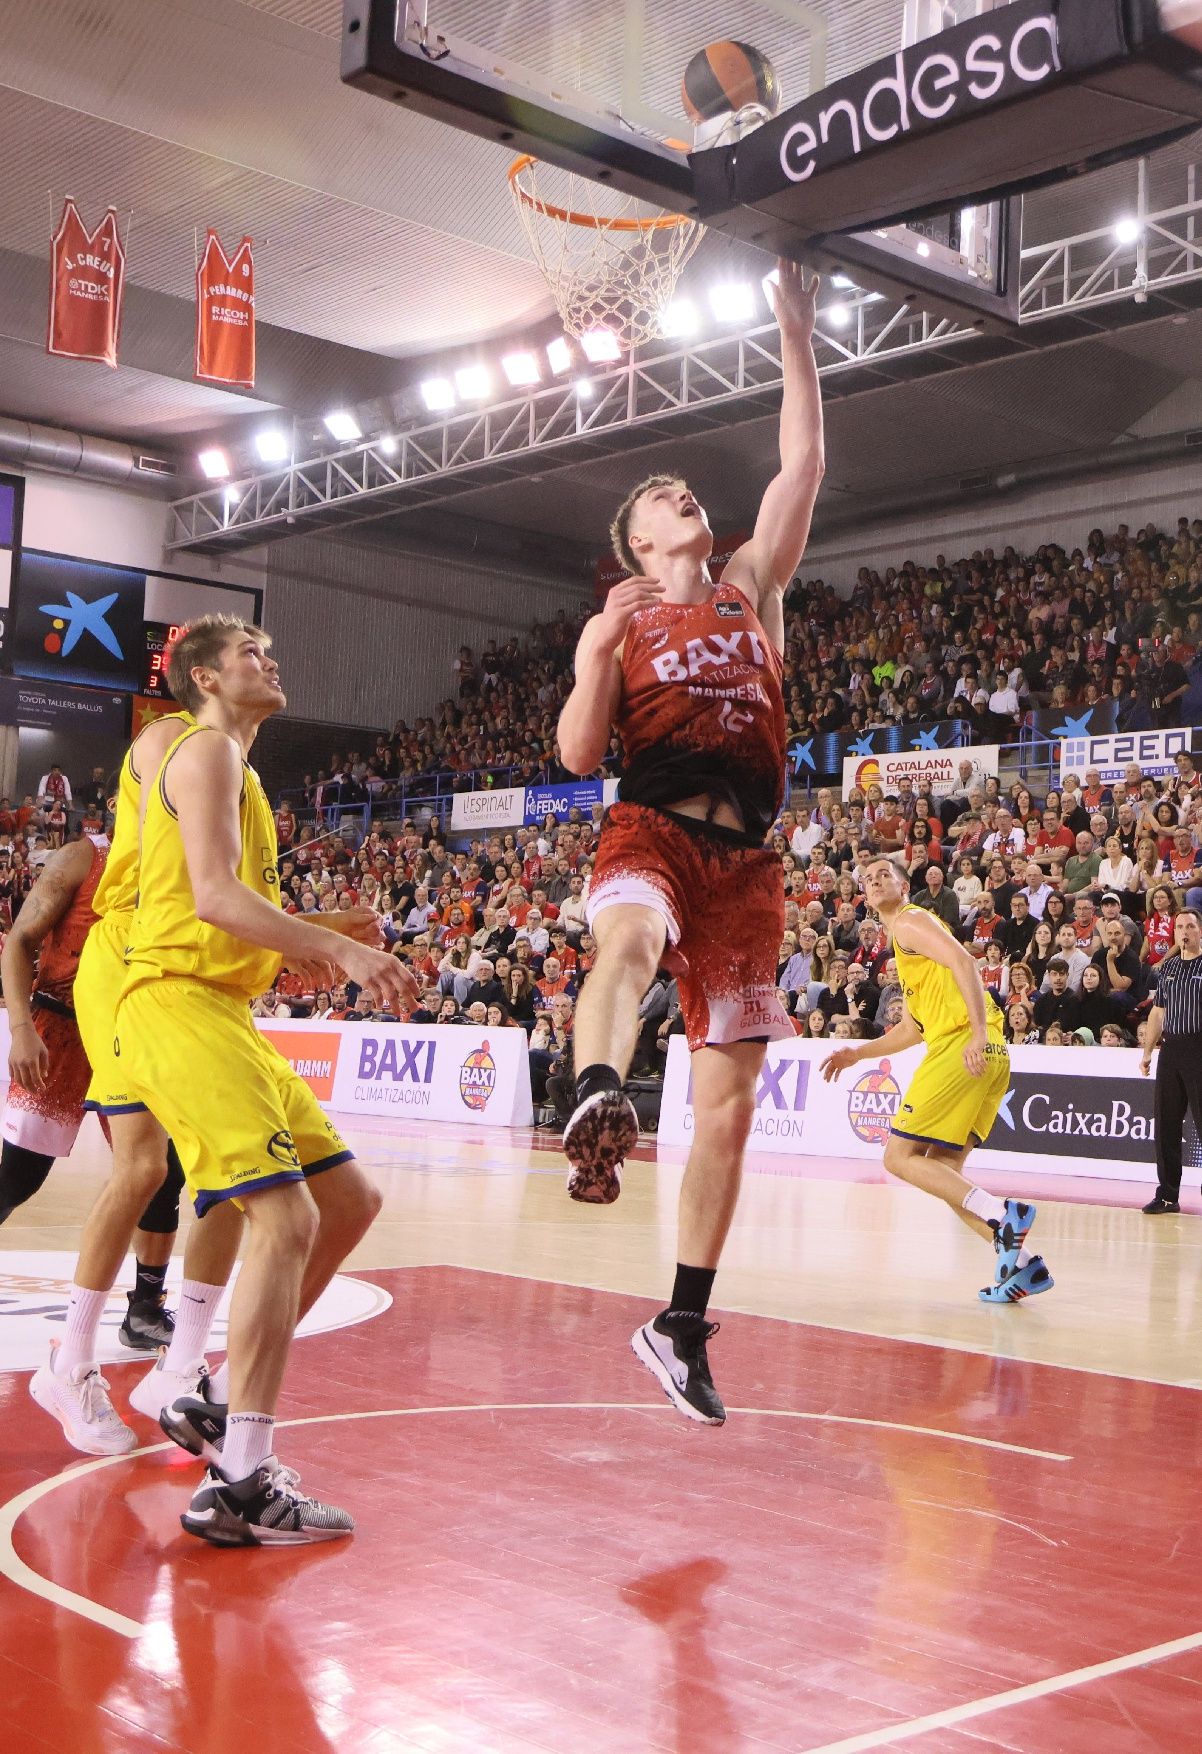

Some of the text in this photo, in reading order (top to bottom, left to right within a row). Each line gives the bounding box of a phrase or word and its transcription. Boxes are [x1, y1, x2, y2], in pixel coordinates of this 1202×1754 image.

[780, 14, 1062, 183] endesa
[102, 238, 111, 251] 7
[77, 254, 115, 279] CREUS
[242, 263, 250, 277] 9
[79, 280, 109, 295] TDK
[212, 306, 249, 320] RICOH
[212, 315, 249, 327] MANRESA
[651, 631, 765, 683] BAXI
[150, 675, 158, 687] 3
[19, 694, 46, 706] TOYOTA
[47, 698, 76, 710] TALLERS
[689, 682, 768, 706] MANRESA
[886, 758, 954, 773] CATALANA
[1100, 768, 1126, 780] BRES
[537, 797, 569, 815] FEDAC
[741, 1014, 789, 1028] GLOBAL
[296, 1059, 332, 1079] DAMM
[358, 1038, 437, 1084] BAXI
[461, 1066, 496, 1087] BAXI
[354, 1085, 432, 1107] CLIMATIZACIÓN
[850, 1091, 902, 1115] BAXI
[856, 1116, 891, 1129] MANRESA
[1022, 1093, 1187, 1143] CaixaBa
